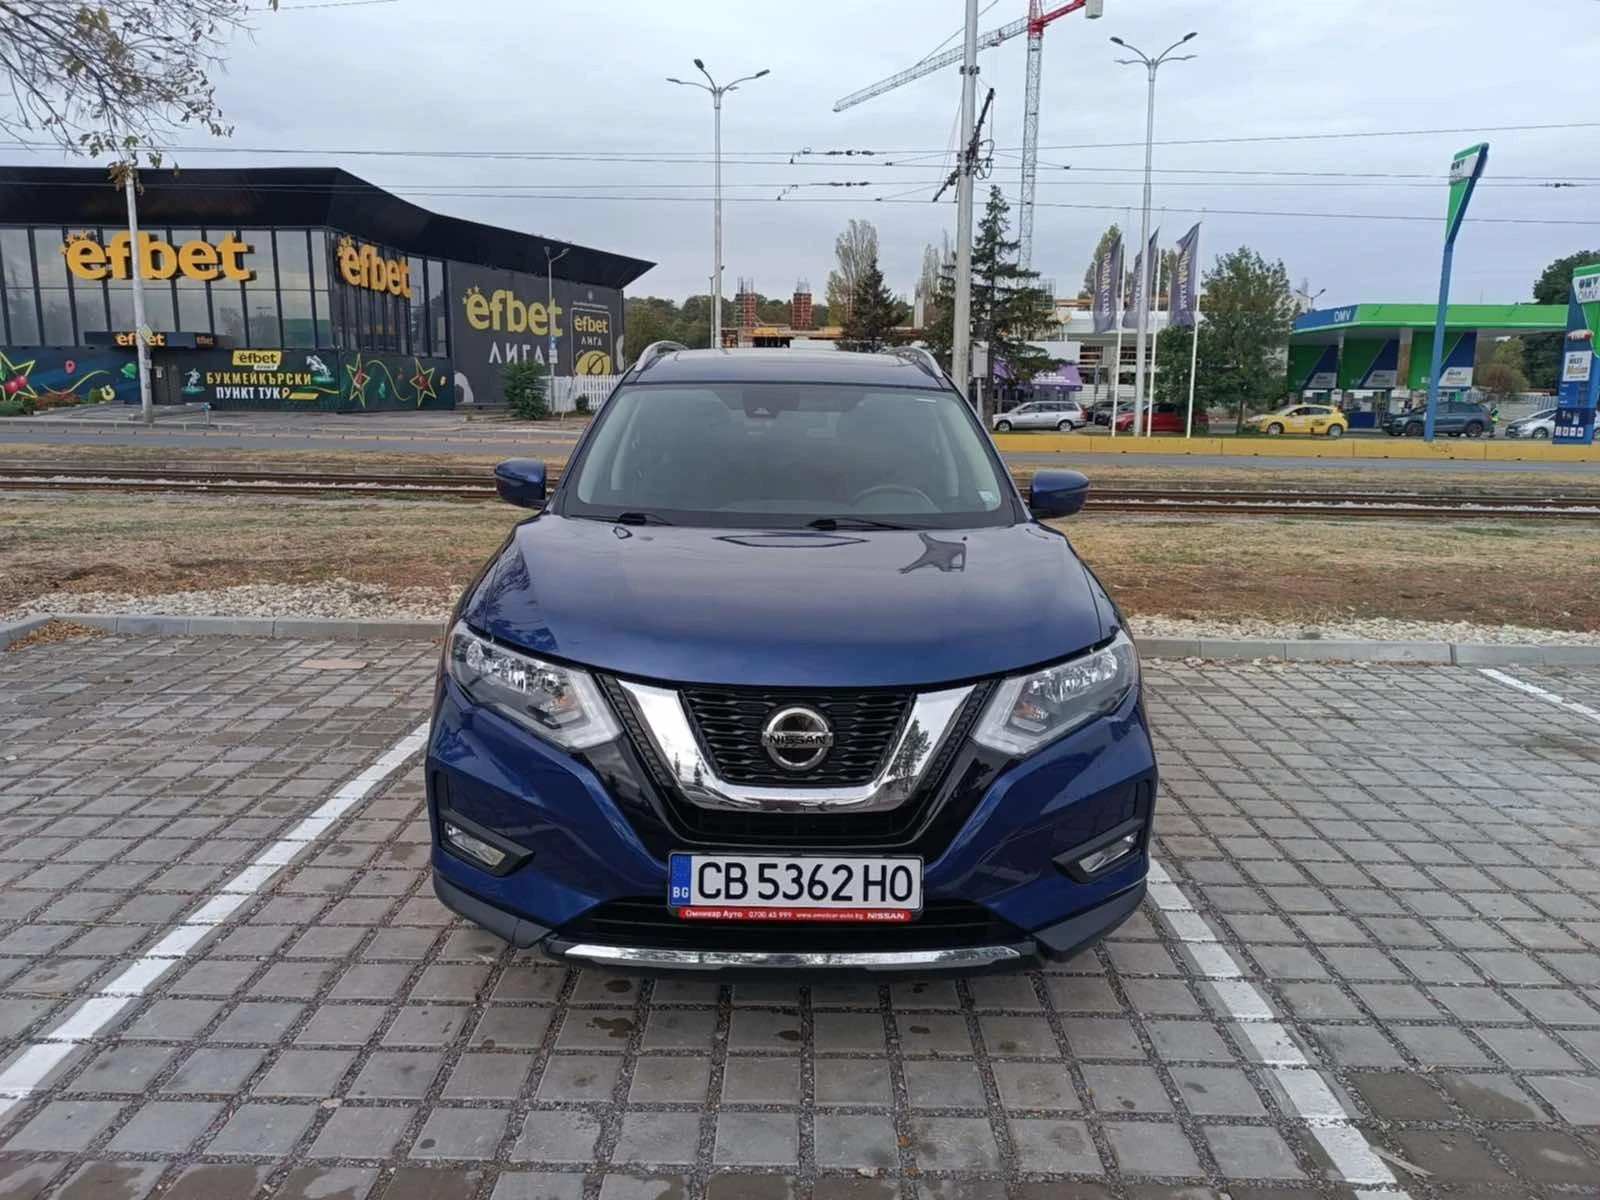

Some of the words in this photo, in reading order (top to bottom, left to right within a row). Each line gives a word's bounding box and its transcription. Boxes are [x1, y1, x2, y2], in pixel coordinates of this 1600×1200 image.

[67, 232, 248, 281] efbet
[341, 244, 412, 299] efbet
[466, 289, 563, 337] efbet
[1334, 309, 1351, 322] OMV
[574, 315, 608, 334] efbet
[116, 332, 165, 346] efet
[581, 335, 602, 346] ЛИГА
[239, 352, 277, 364] efbet
[488, 341, 545, 366] ЛИГА
[206, 372, 312, 385] БУКМЕЙКЪРСКИ
[216, 387, 255, 399] ПУНКТ
[259, 387, 281, 399] ТУК
[769, 735, 826, 745] NISSAN
[673, 886, 689, 899] BG
[867, 912, 905, 920] NISSAN
